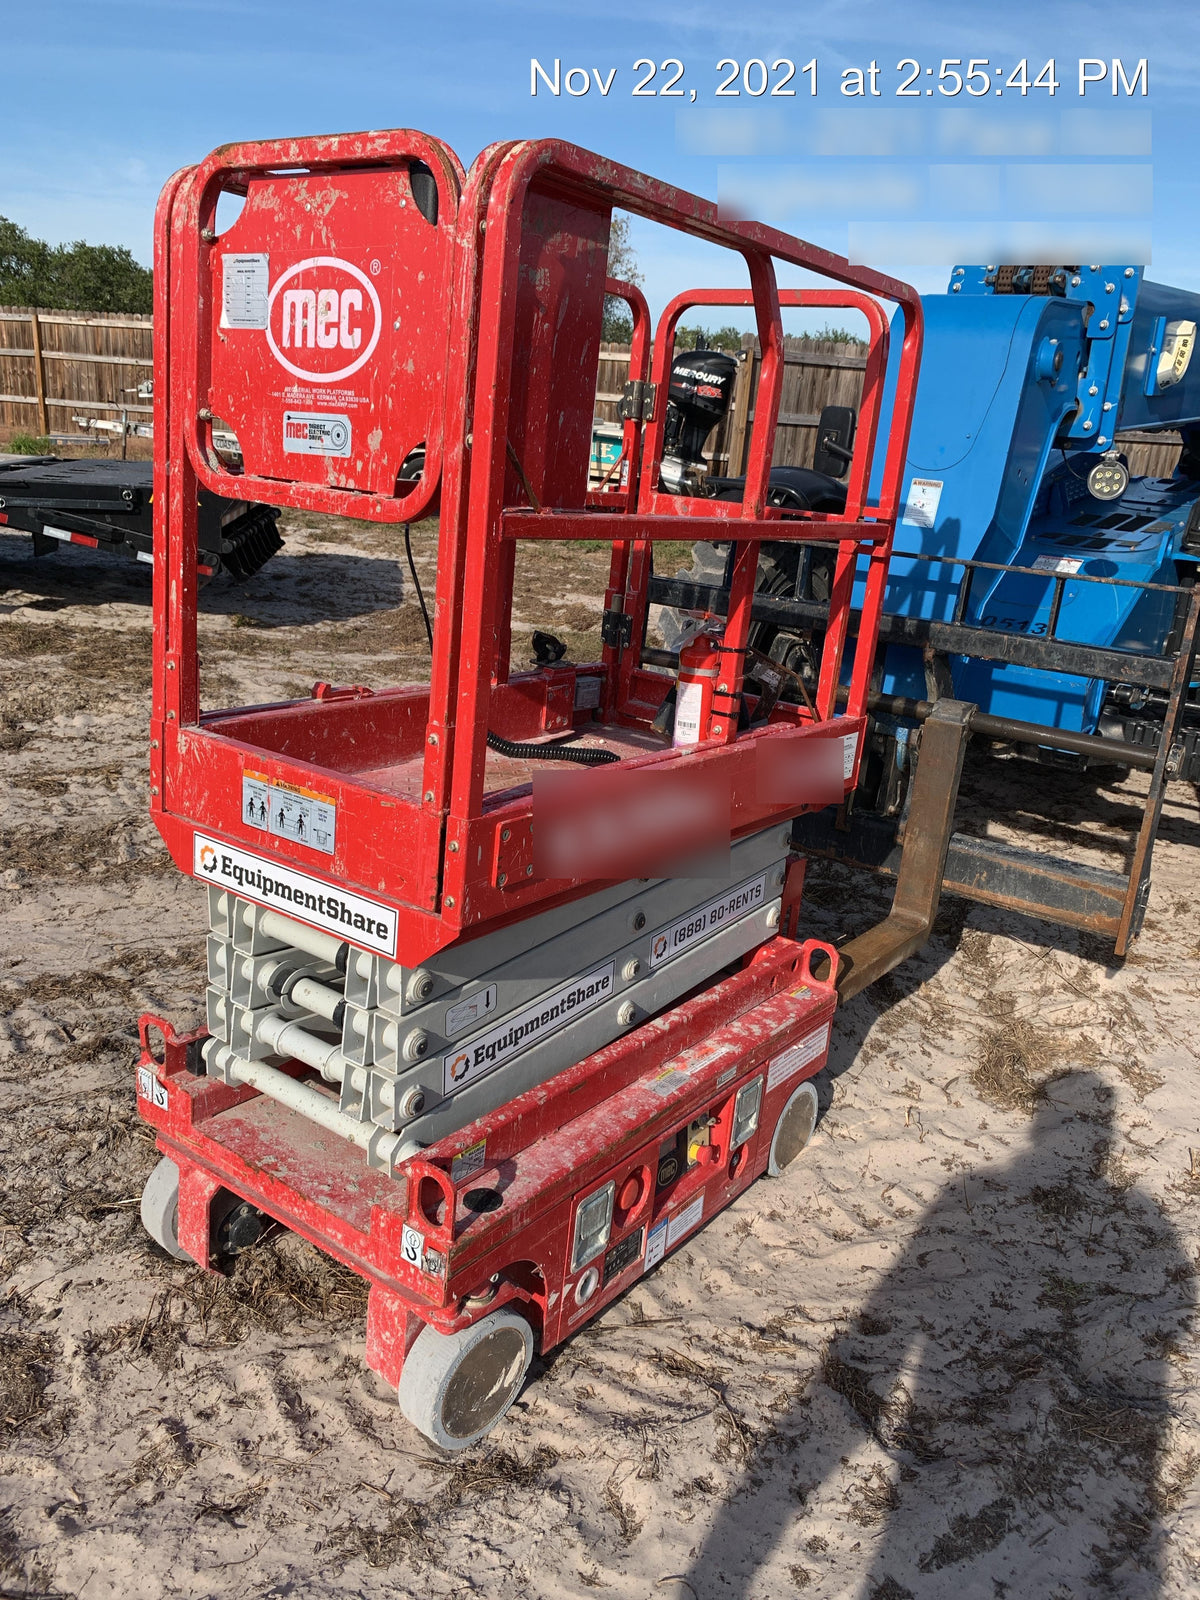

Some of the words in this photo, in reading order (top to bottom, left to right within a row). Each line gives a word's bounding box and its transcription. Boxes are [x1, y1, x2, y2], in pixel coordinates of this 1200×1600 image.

[326, 389, 355, 397] PLATFORMS
[220, 854, 389, 941] EquipmentShare
[673, 914, 707, 947] (888)
[709, 884, 762, 925] 80-RENTS
[472, 974, 610, 1068] EquipmentShare
